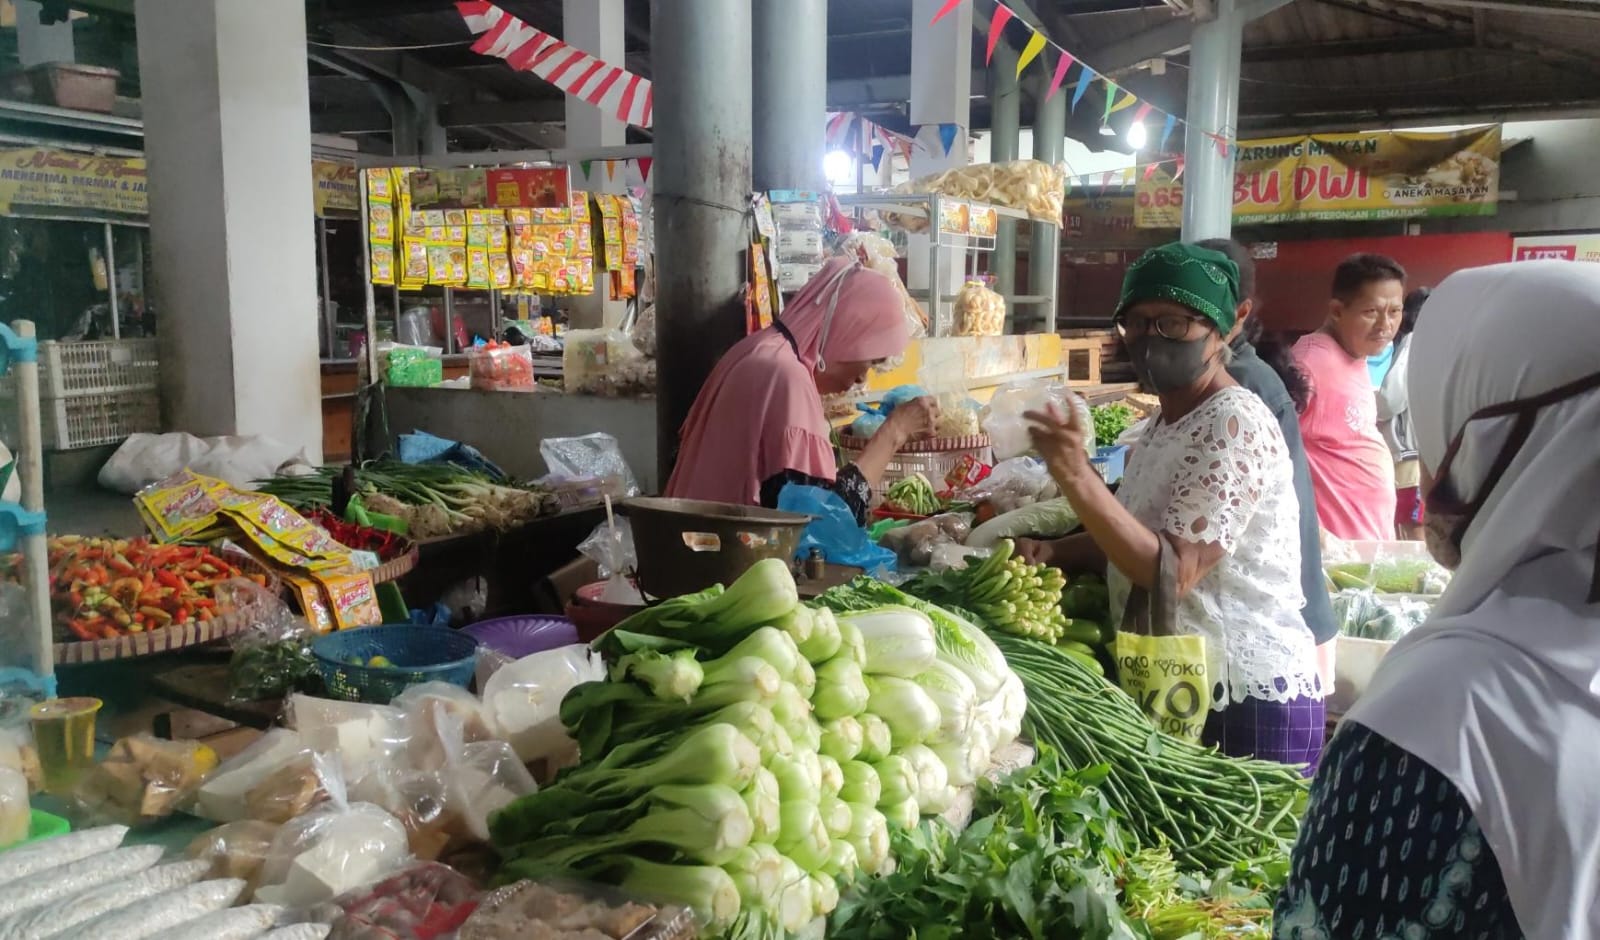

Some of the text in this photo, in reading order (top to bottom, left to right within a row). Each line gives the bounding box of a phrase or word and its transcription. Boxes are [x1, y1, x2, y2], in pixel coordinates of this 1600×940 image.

[1308, 139, 1377, 156] MAKAN
[1294, 165, 1369, 202] DWI
[1394, 185, 1489, 198] ANEKA MASAKAN
[1159, 663, 1205, 677] YOKO
